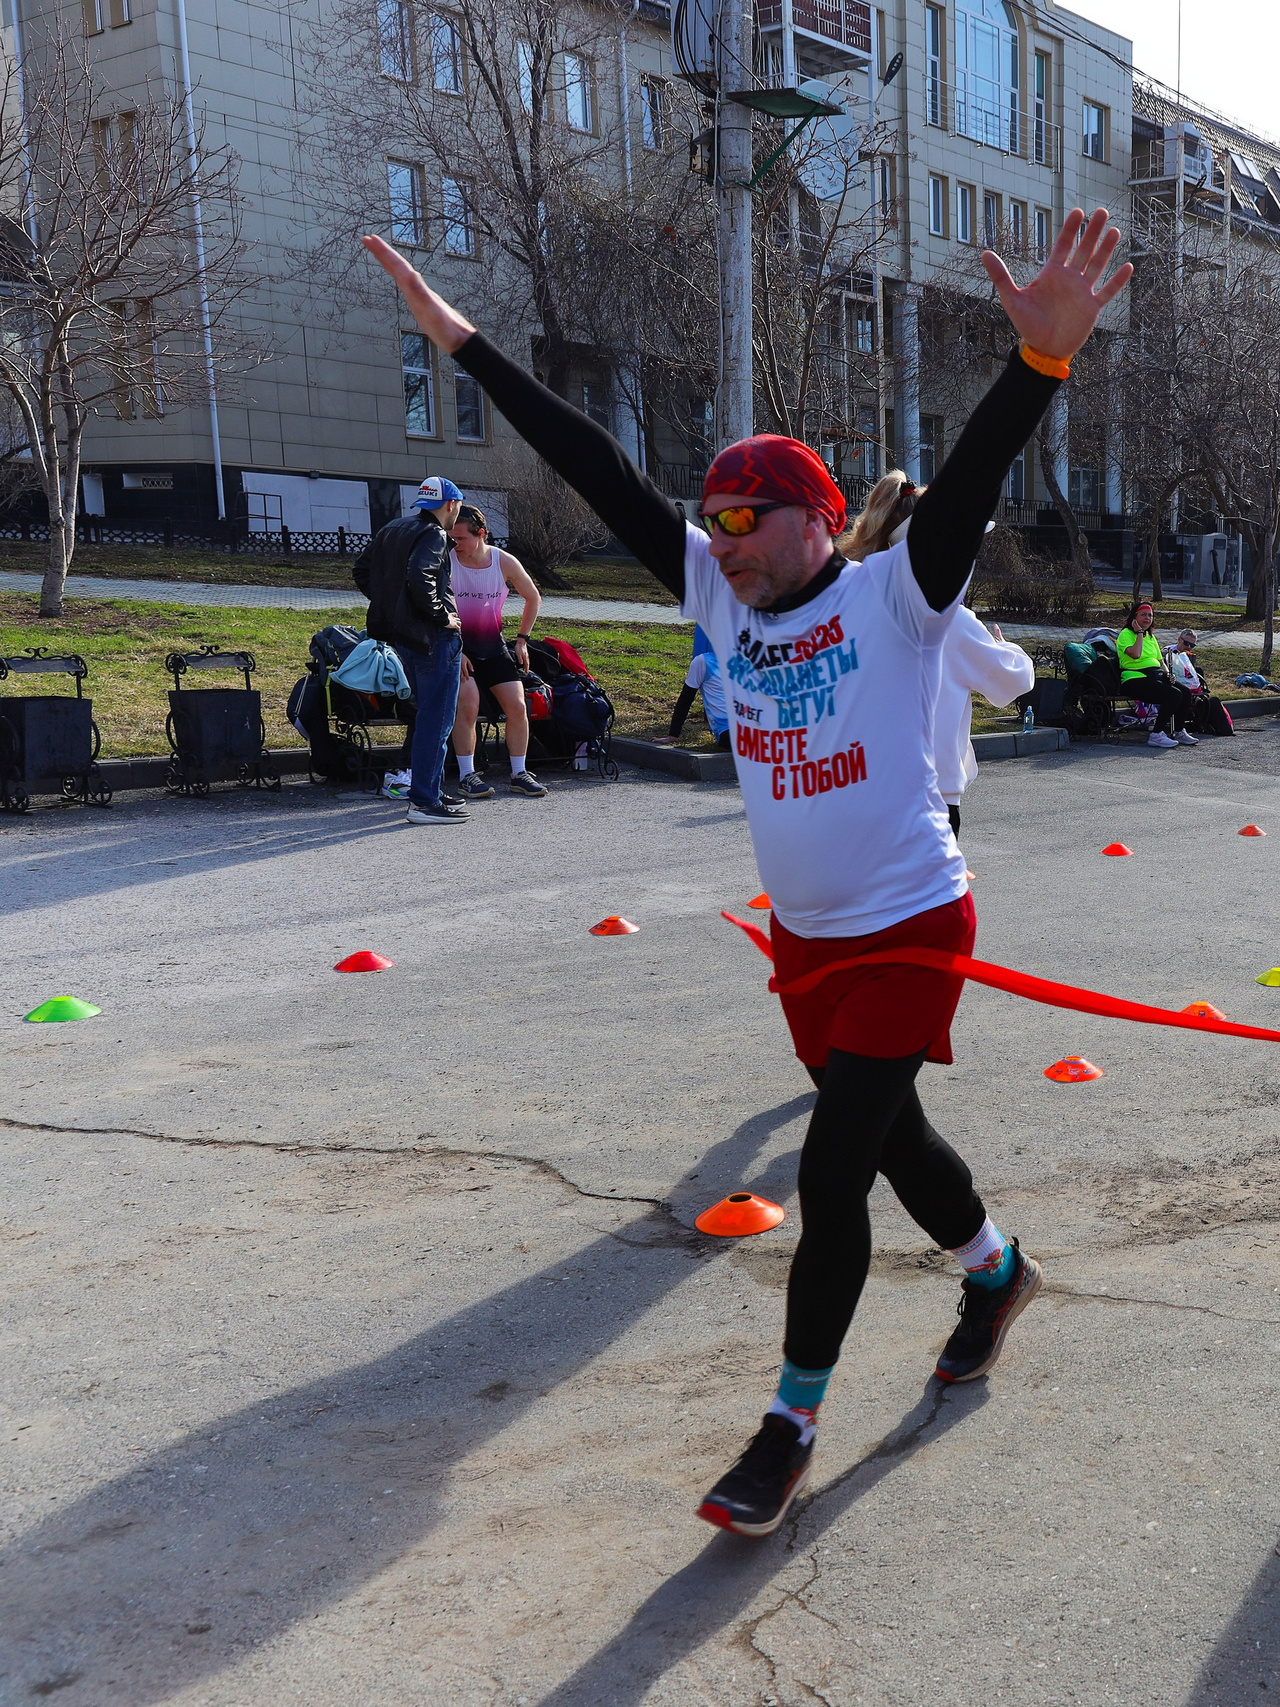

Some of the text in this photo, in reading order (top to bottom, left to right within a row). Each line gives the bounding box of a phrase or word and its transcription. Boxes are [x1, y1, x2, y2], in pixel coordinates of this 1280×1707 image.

[774, 684, 836, 729] БЕГУТ
[736, 720, 808, 765] ВМЕСТЕ
[771, 740, 868, 801] С ТОБОЙ
